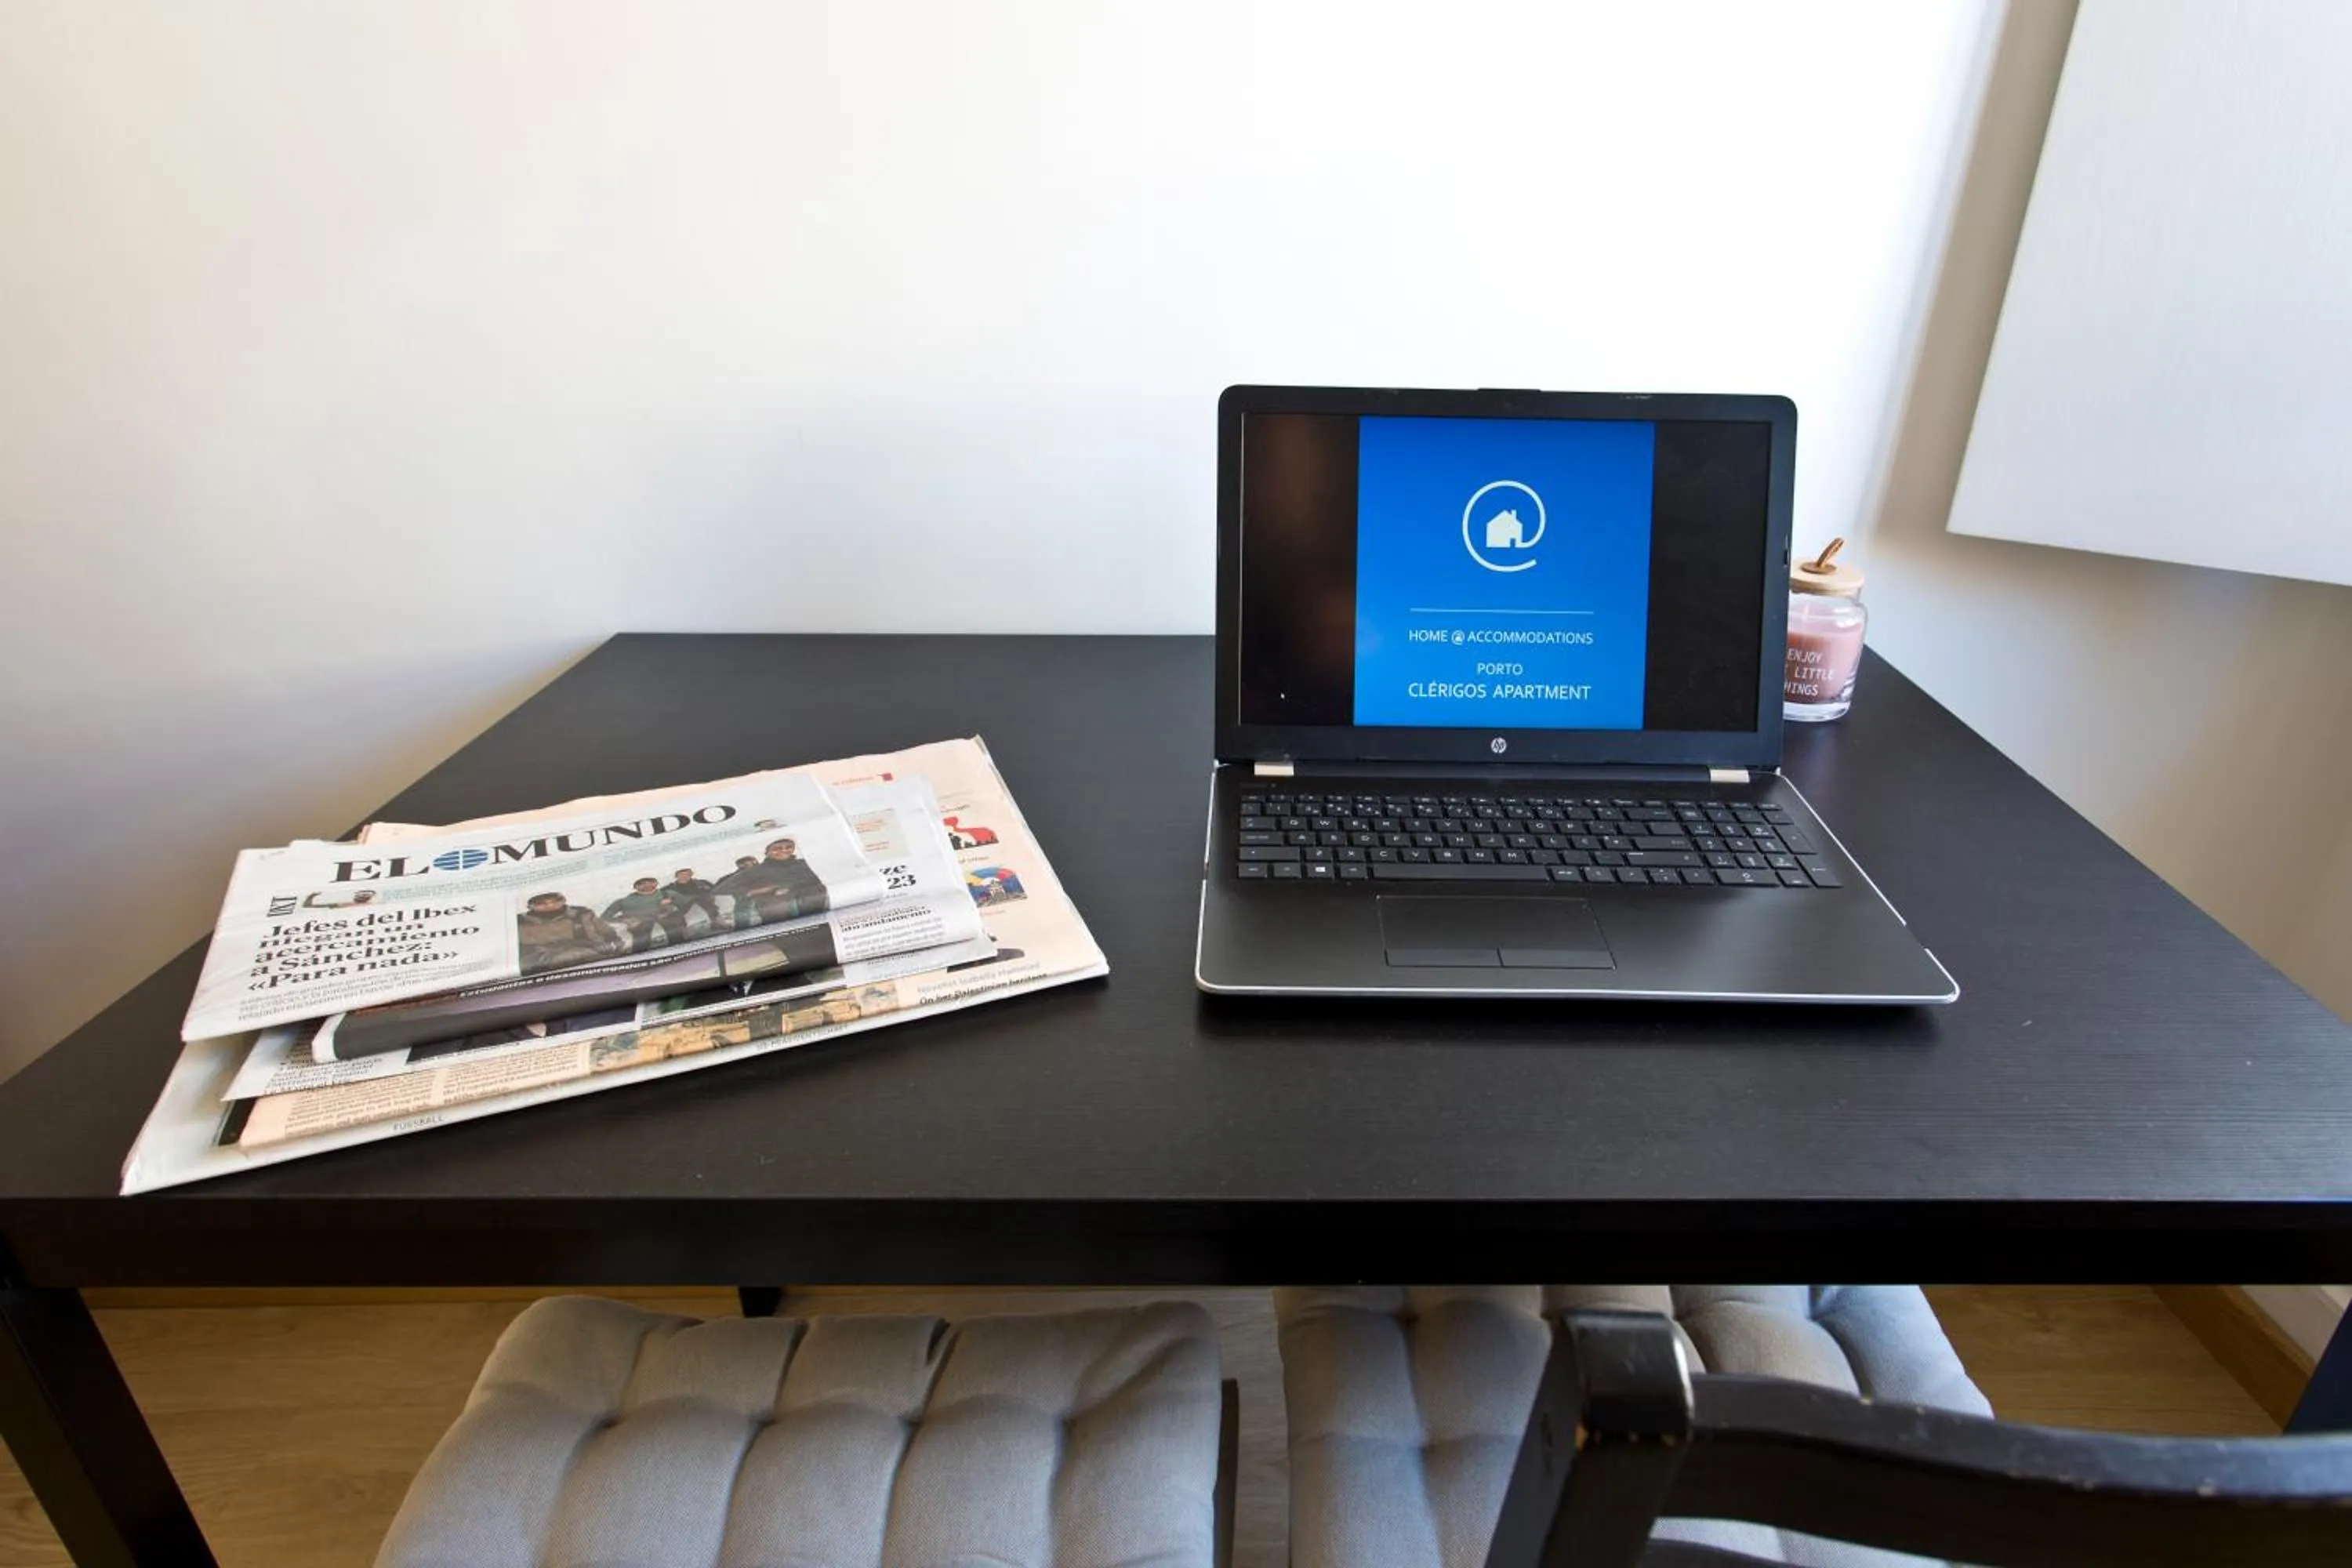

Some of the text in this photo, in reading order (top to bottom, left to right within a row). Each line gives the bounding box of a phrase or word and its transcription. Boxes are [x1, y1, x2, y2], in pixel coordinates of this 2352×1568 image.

[1408, 630, 1448, 643] HOME
[1467, 630, 1594, 644] ACCOMMODATIONS
[1787, 648, 1823, 663] ENJOY
[1476, 662, 1523, 675] PORTO
[1794, 666, 1835, 680] LITTLE
[1408, 681, 1592, 700] CLÉRIGOS APARTMENT
[1784, 681, 1819, 696] HINGS
[330, 856, 430, 883] EL
[492, 804, 737, 866] MUNDO
[887, 874, 916, 890] 23
[263, 904, 477, 938] Jefes del Ibex
[255, 924, 481, 964] acercamiento
[258, 923, 424, 949] niegan un
[250, 941, 432, 977] a Sánchez:
[248, 966, 347, 991] «Para
[357, 950, 459, 972] nada»
